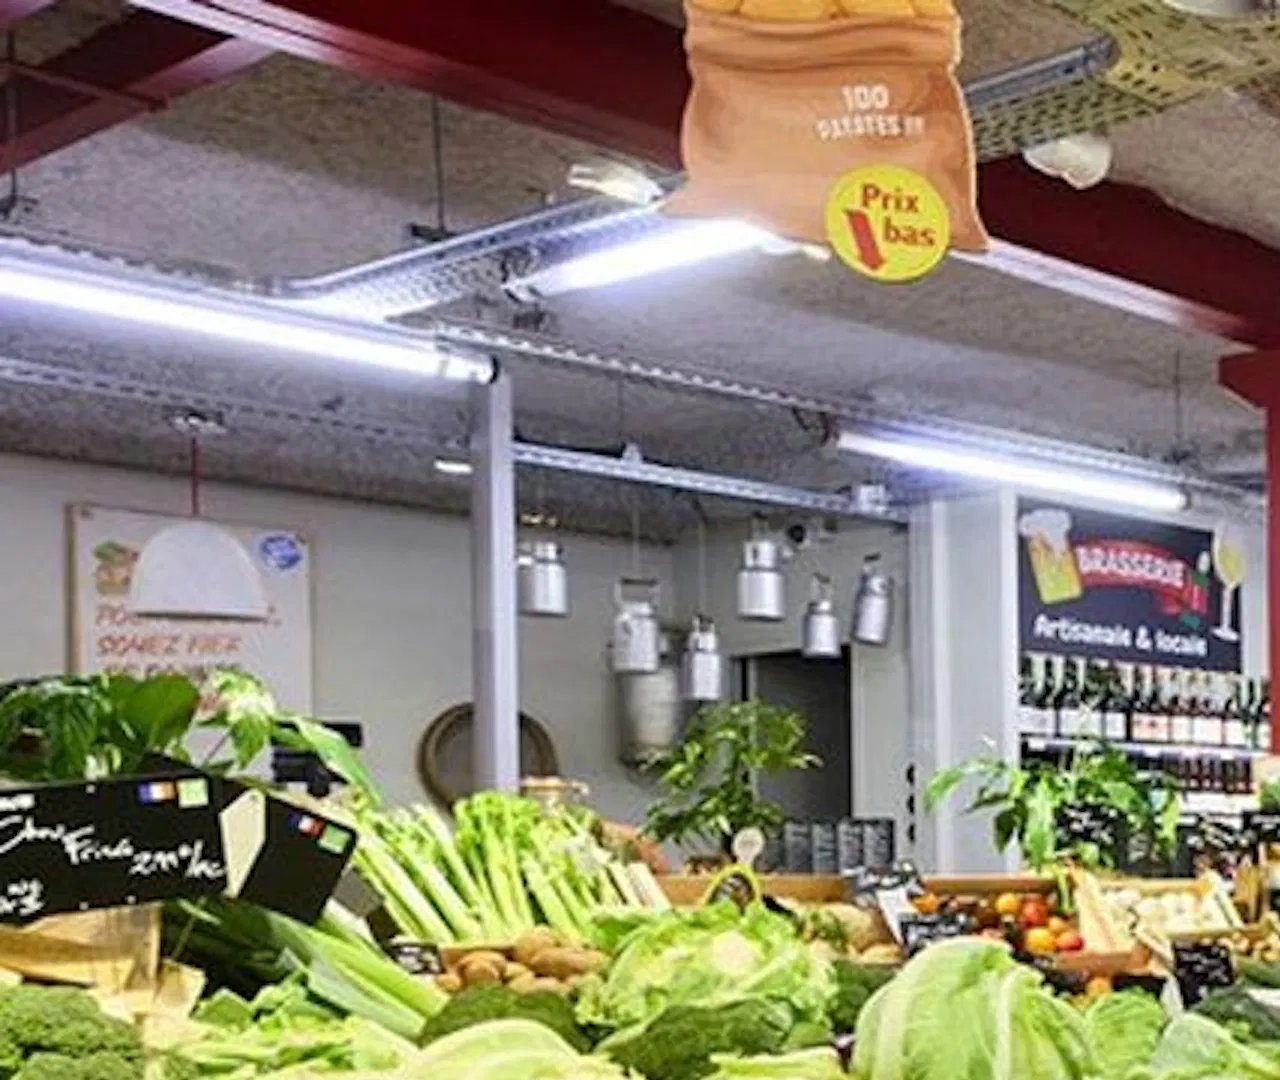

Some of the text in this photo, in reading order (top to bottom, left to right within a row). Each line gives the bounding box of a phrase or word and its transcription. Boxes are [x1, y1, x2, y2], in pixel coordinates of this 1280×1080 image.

[841, 84, 890, 111] 100
[862, 182, 919, 214] Prix
[883, 216, 936, 246] bas
[1077, 547, 1186, 588] BRASSERIE
[1136, 624, 1152, 651] &
